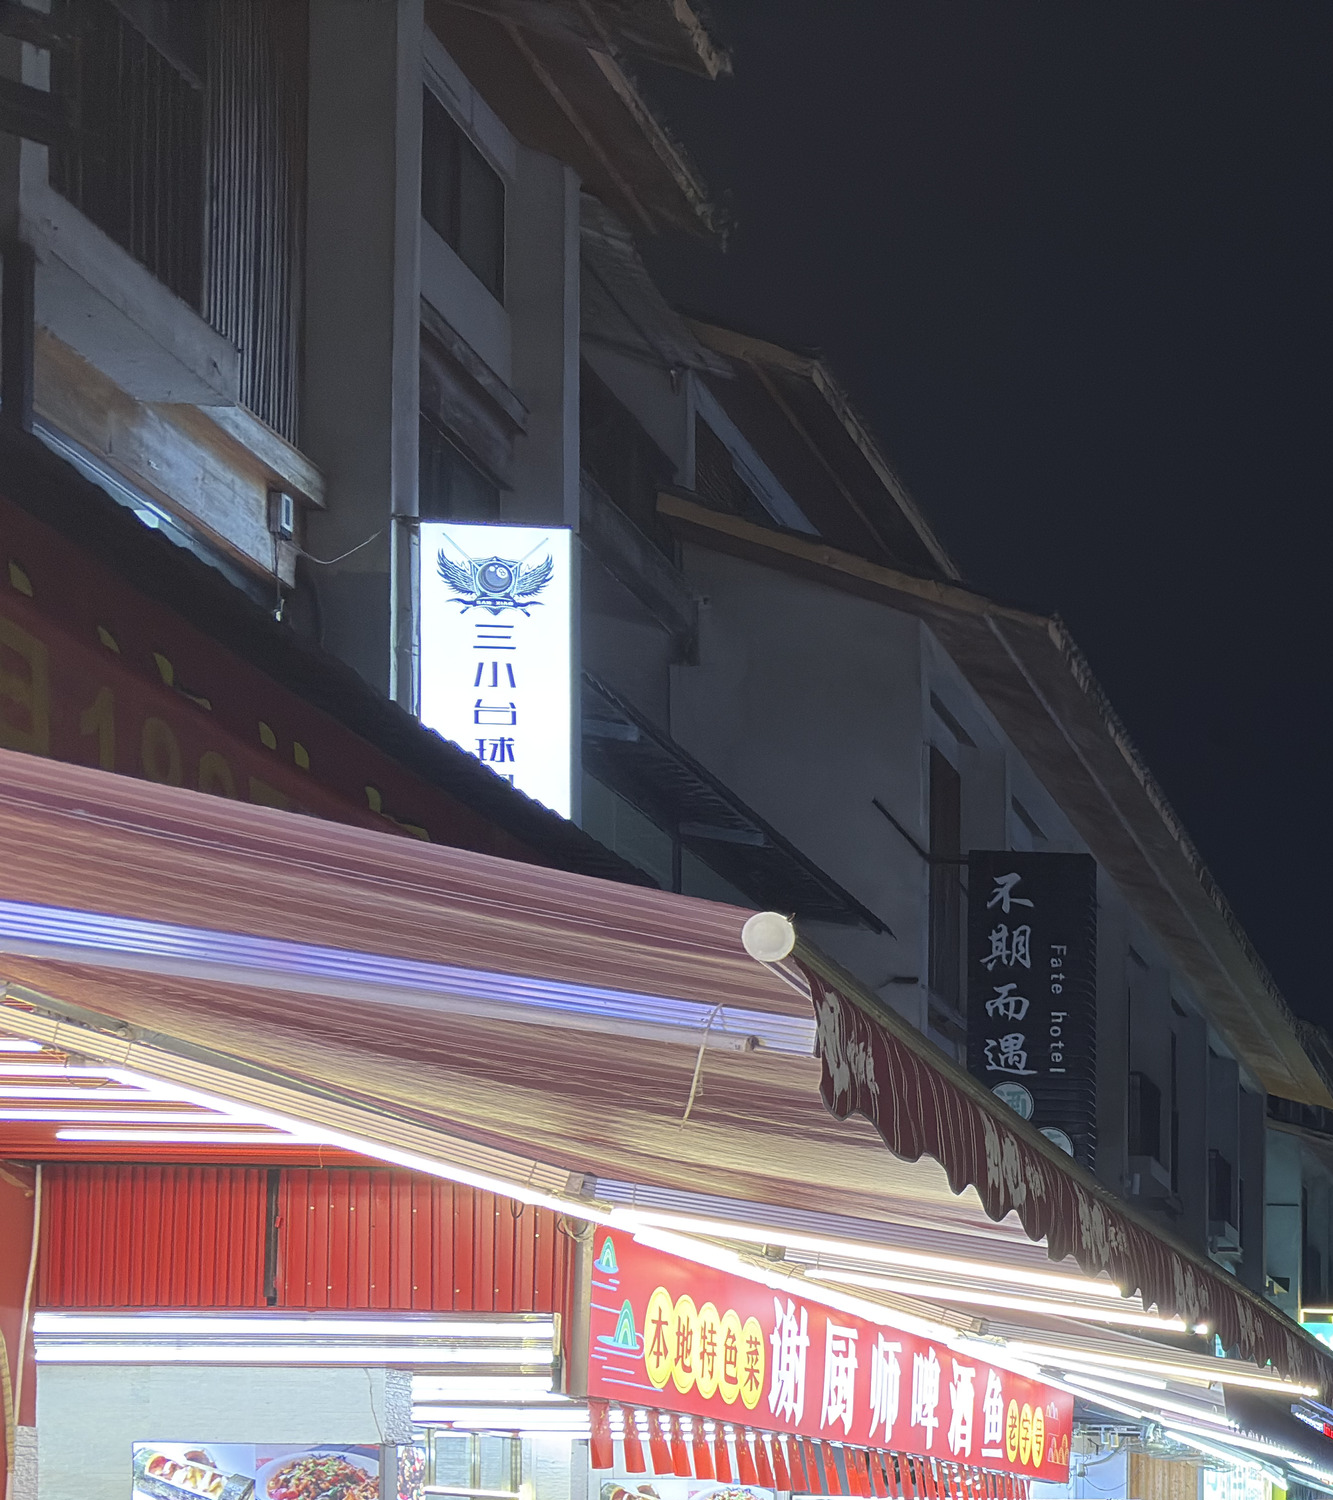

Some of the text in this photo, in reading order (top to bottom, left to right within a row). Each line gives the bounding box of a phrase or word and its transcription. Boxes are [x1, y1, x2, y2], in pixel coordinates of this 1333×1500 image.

[472, 623, 517, 788] 三小台球
[979, 872, 1038, 1076] 不期而遇
[1049, 943, 1067, 1073] Fate hotel
[648, 1306, 761, 1393] 本地特色菜
[767, 1294, 1005, 1460] 谢厨师啤酒鱼
[1008, 1410, 1044, 1459] 老字号
